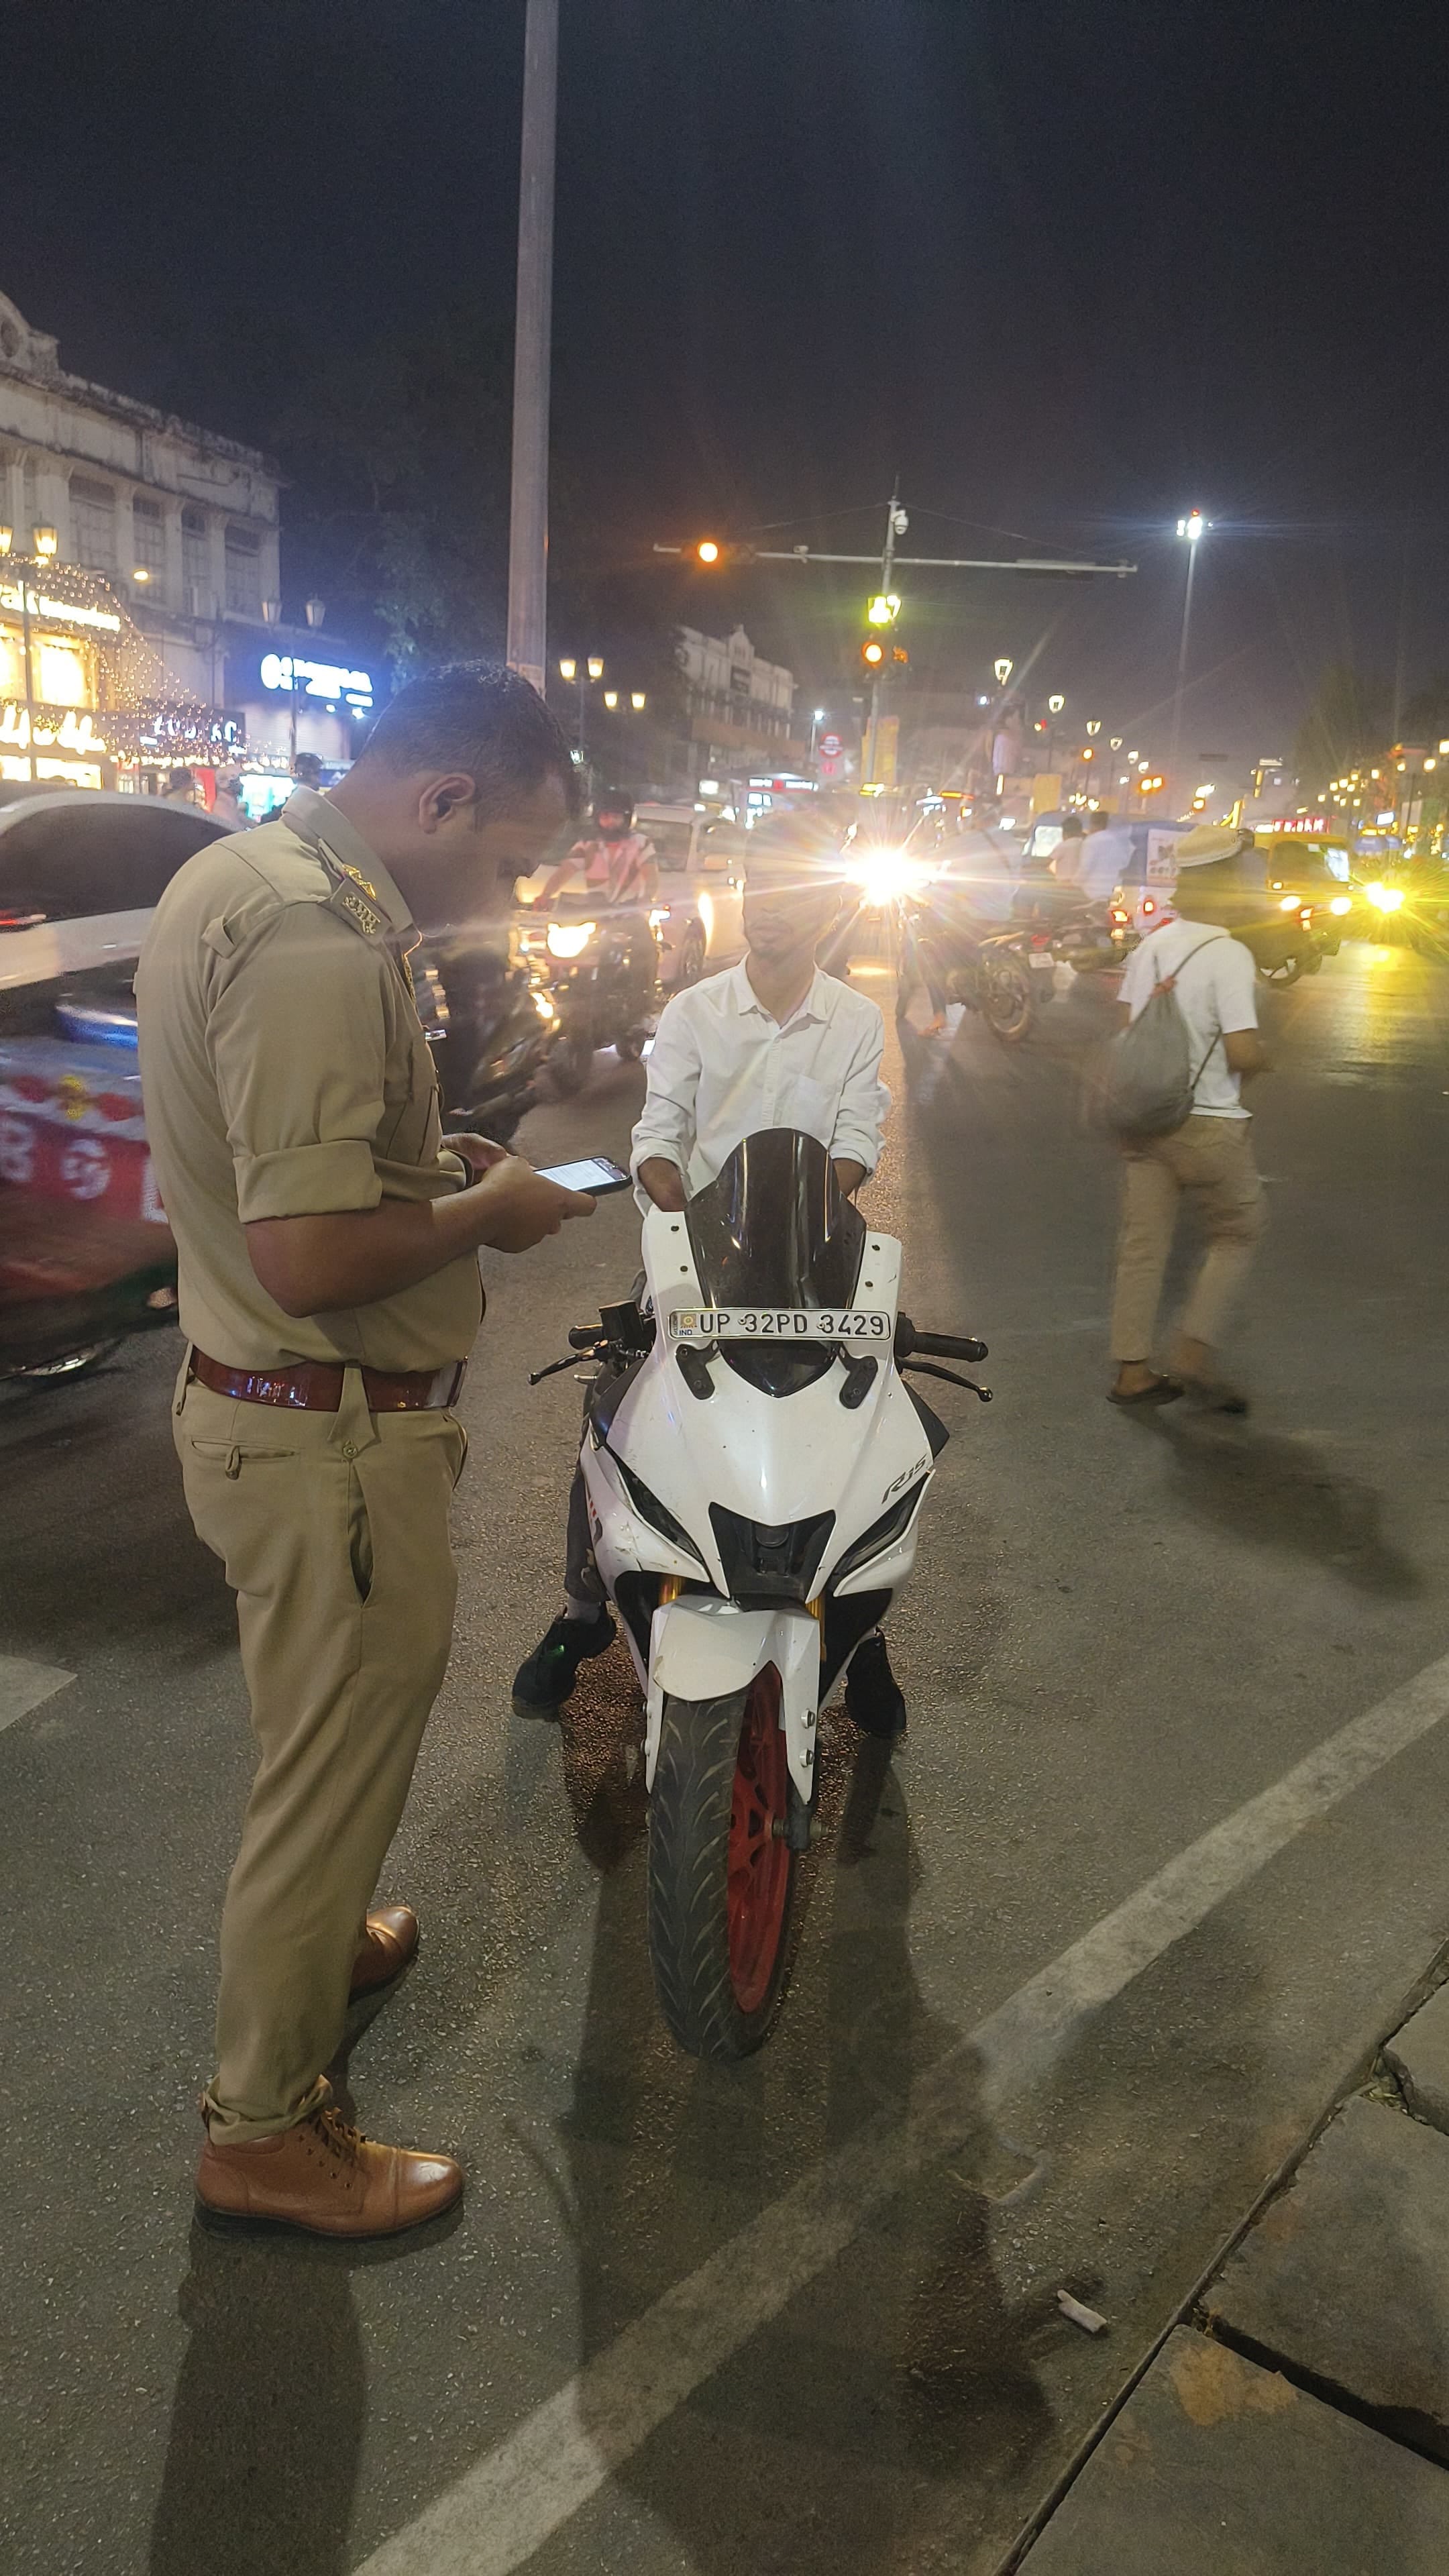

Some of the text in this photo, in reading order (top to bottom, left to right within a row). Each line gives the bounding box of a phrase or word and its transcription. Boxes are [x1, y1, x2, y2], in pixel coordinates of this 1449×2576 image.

[700, 1313, 731, 1334] UP
[745, 1313, 808, 1334] 32PD
[819, 1314, 884, 1336] 3429
